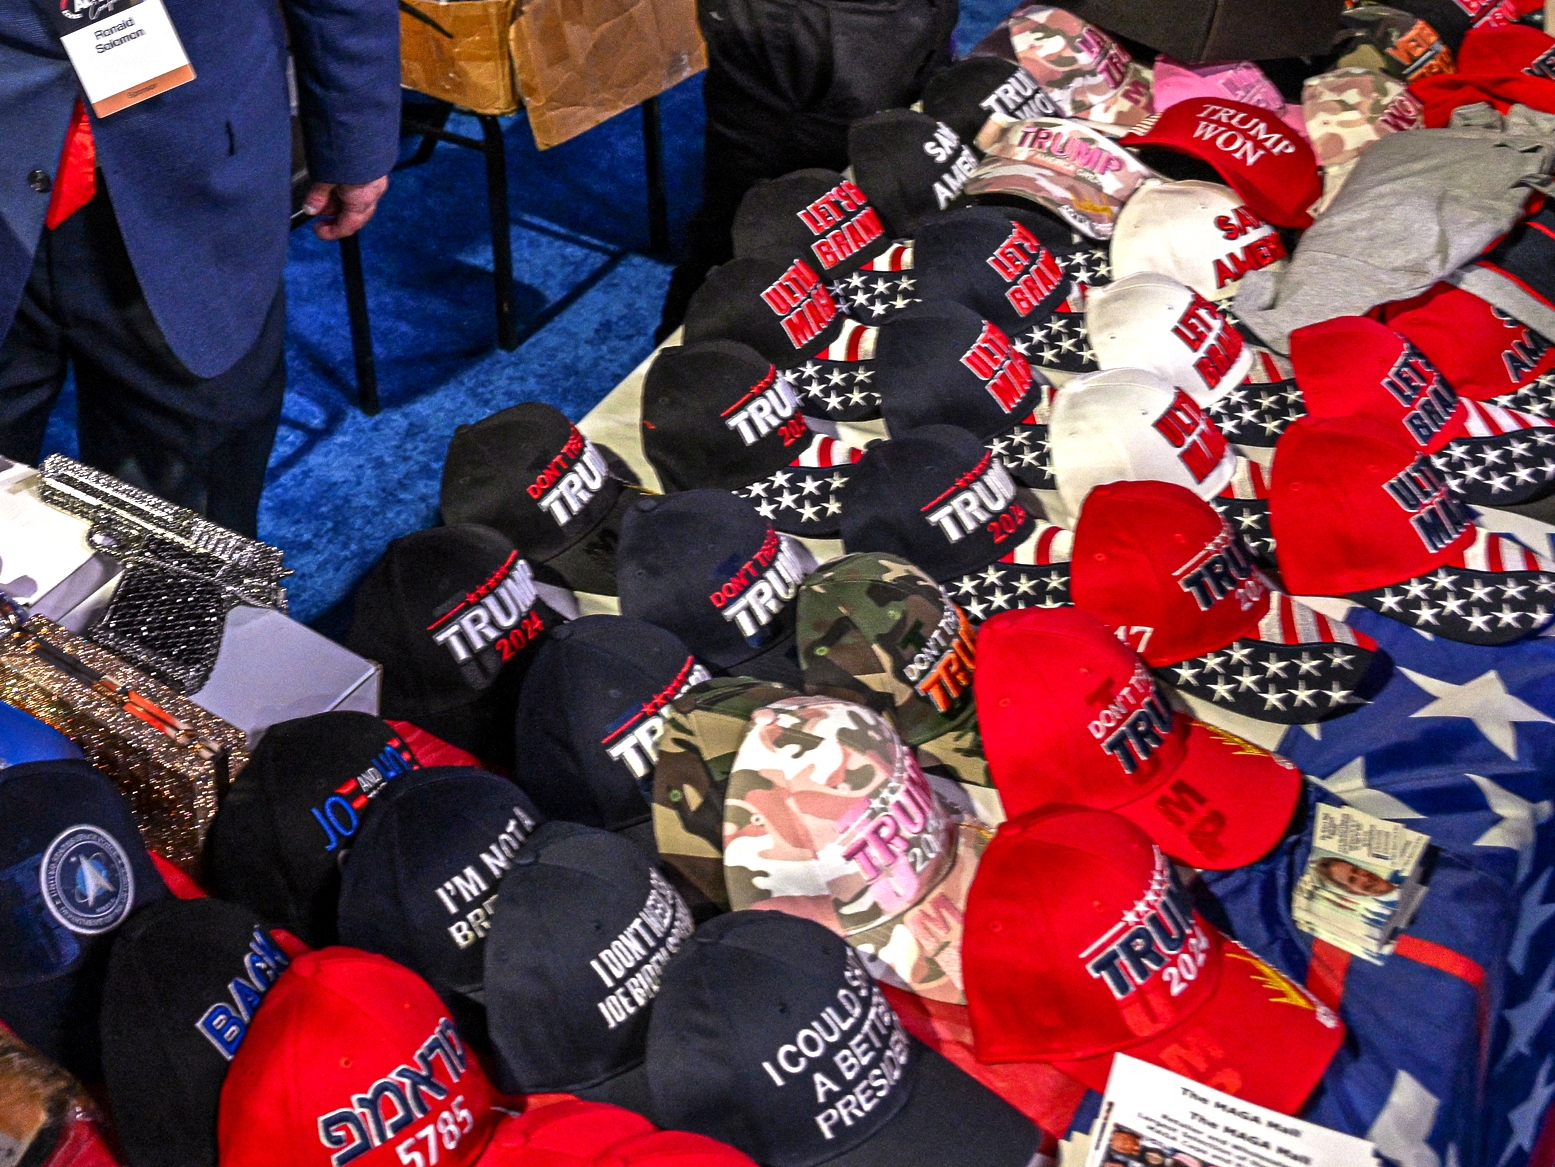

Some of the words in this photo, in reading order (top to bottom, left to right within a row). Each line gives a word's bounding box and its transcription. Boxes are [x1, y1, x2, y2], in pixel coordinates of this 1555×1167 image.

[94, 17, 136, 41] Ronald
[95, 27, 146, 55] Solomon
[979, 67, 1041, 115] TRU
[1018, 125, 1124, 176] TRUMP
[1192, 120, 1268, 168] WON
[1195, 103, 1297, 158] TRUMP
[810, 206, 886, 271] BRAN
[723, 367, 807, 447] TRU
[538, 433, 611, 528] TRU
[925, 455, 1018, 544] TRU
[722, 531, 806, 638] TRU
[1177, 539, 1254, 612] TRU
[1100, 682, 1176, 775] TRU
[434, 866, 488, 915] I'M
[1086, 877, 1197, 1000] TRU
[761, 1061, 786, 1088] I
[777, 988, 864, 1075] COULD
[813, 1072, 842, 1104] A
[1180, 1086, 1210, 1106] The
[1213, 1100, 1263, 1126] MAGA
[1265, 1120, 1303, 1138] Mall
[396, 1094, 475, 1167] 5785
[1189, 1110, 1220, 1131] The
[1223, 1124, 1273, 1151] MAGA
[1275, 1145, 1313, 1166] Mall
